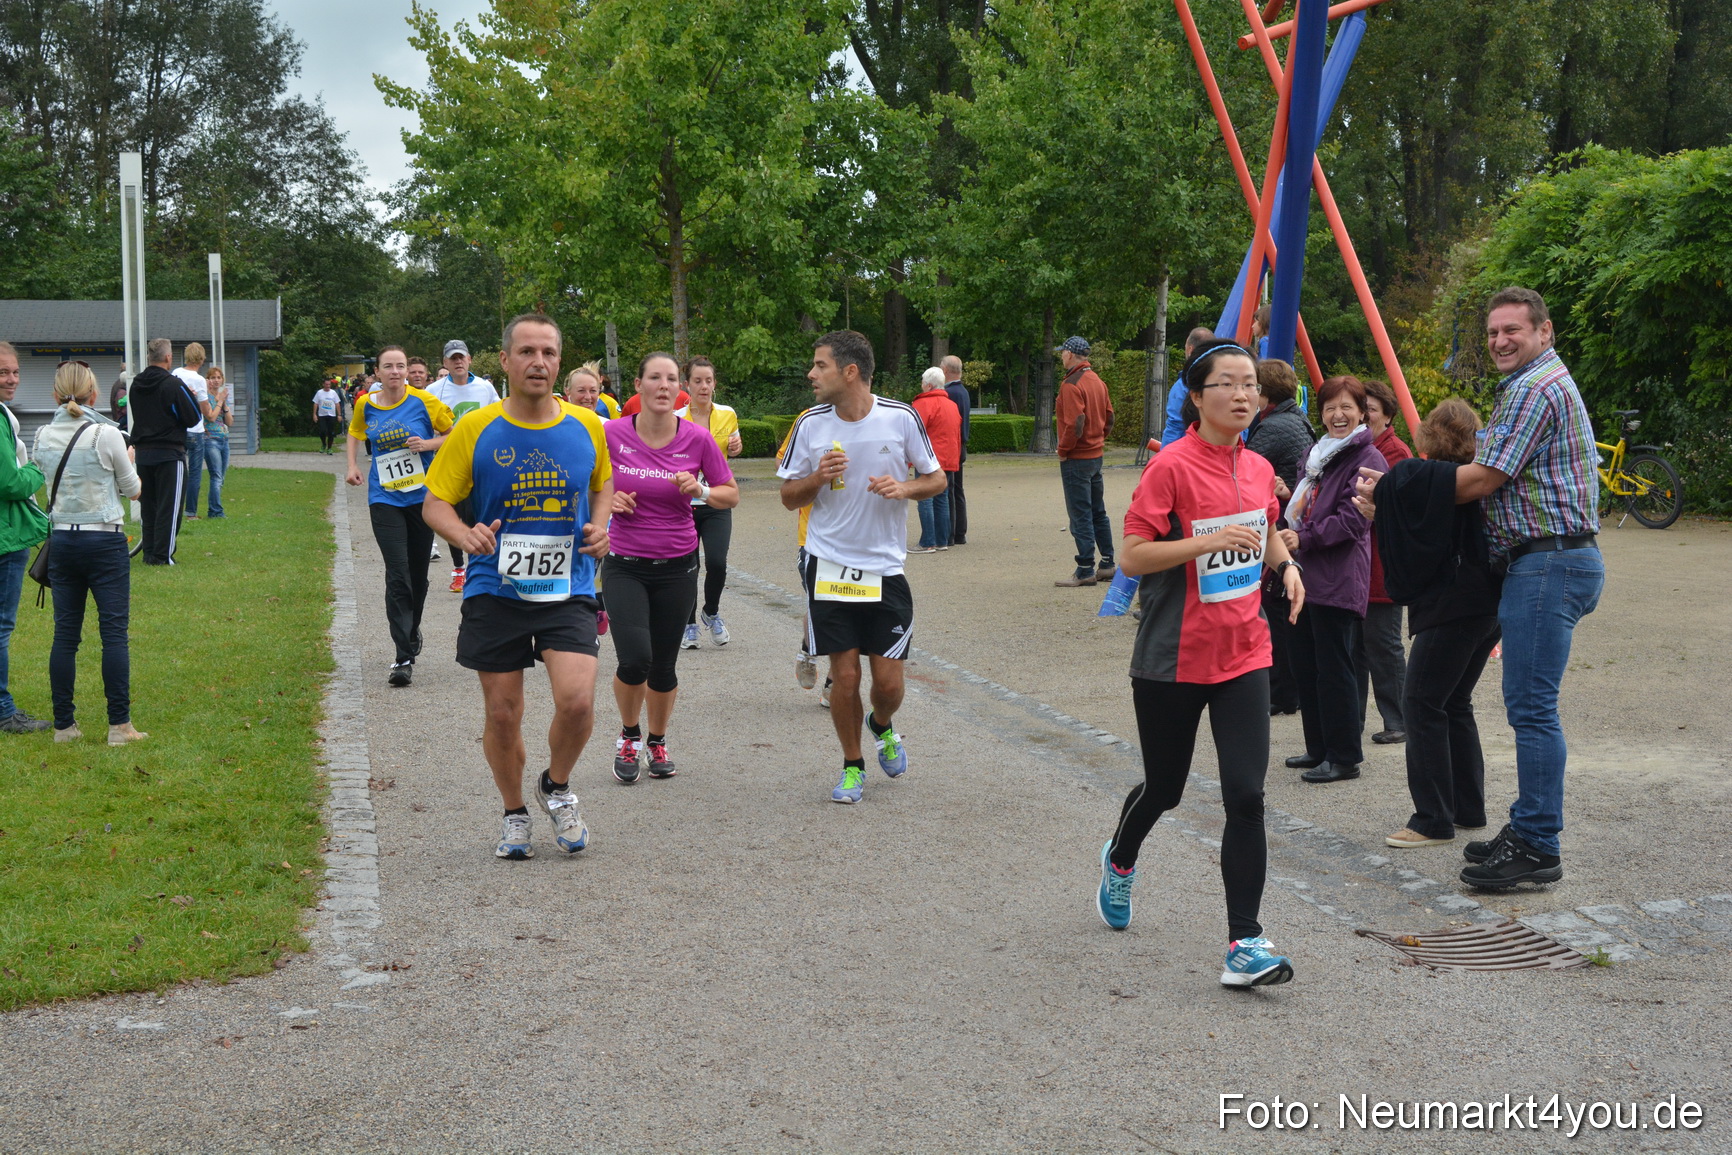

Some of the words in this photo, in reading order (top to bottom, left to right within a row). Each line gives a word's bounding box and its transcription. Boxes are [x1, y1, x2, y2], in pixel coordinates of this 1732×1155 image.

[386, 459, 414, 479] 115
[394, 479, 414, 489] Andrea
[507, 551, 565, 575] 2152
[1227, 574, 1250, 587] Chen
[830, 584, 866, 595] Matthias
